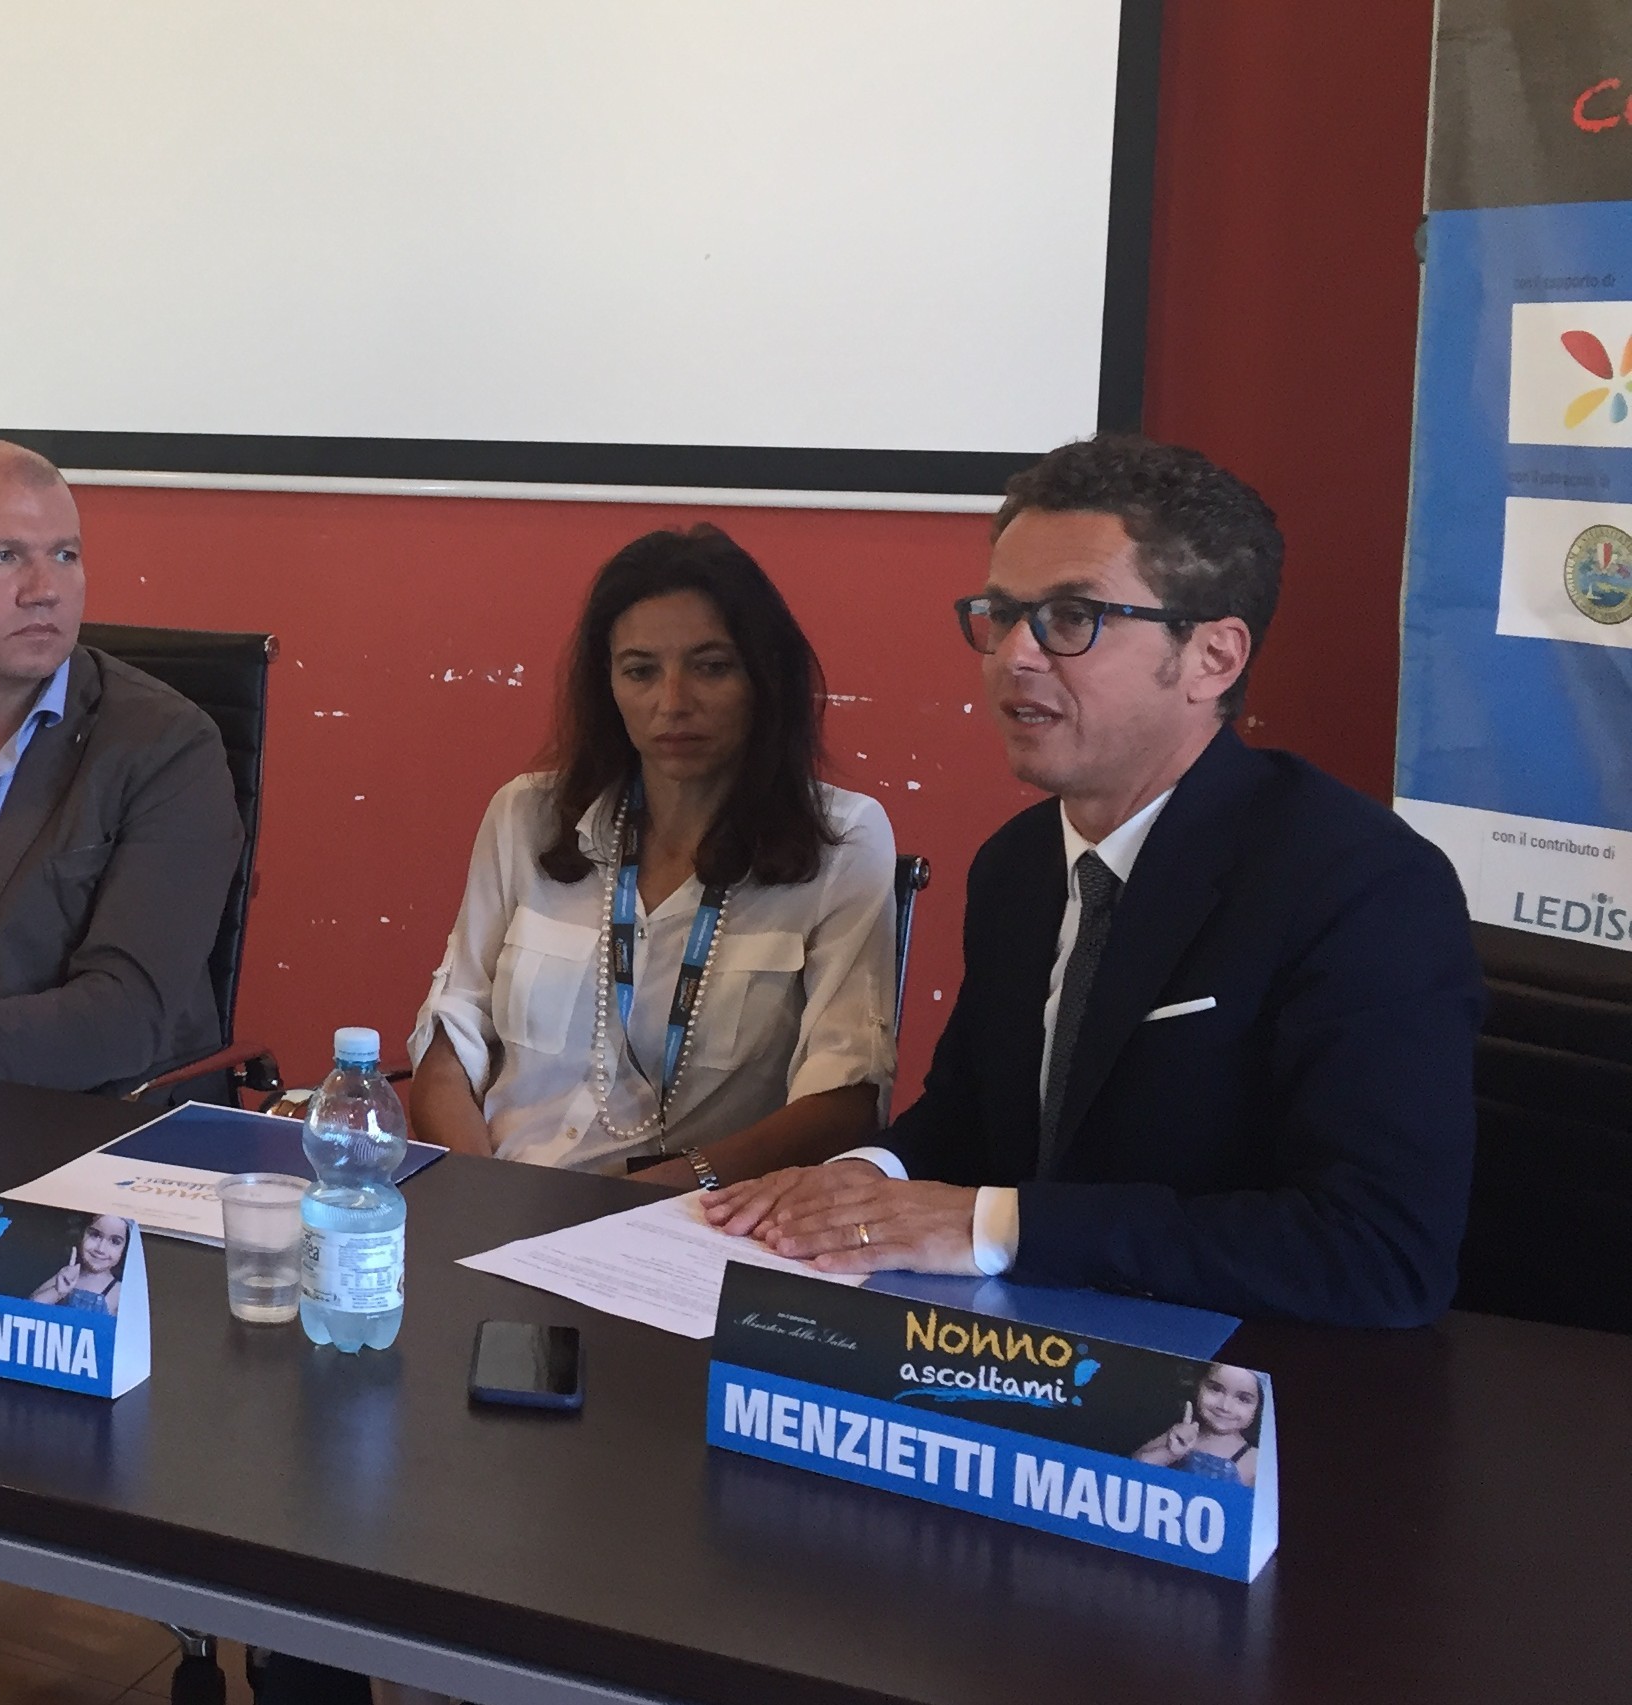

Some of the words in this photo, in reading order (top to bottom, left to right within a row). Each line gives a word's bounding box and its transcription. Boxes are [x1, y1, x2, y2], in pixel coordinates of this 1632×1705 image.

[1492, 831, 1516, 844] con
[1519, 832, 1527, 846] il
[1530, 836, 1599, 858] contributo
[1602, 845, 1615, 860] di
[724, 1383, 996, 1498] MENZIETTI
[1014, 1451, 1225, 1554] MAURO
